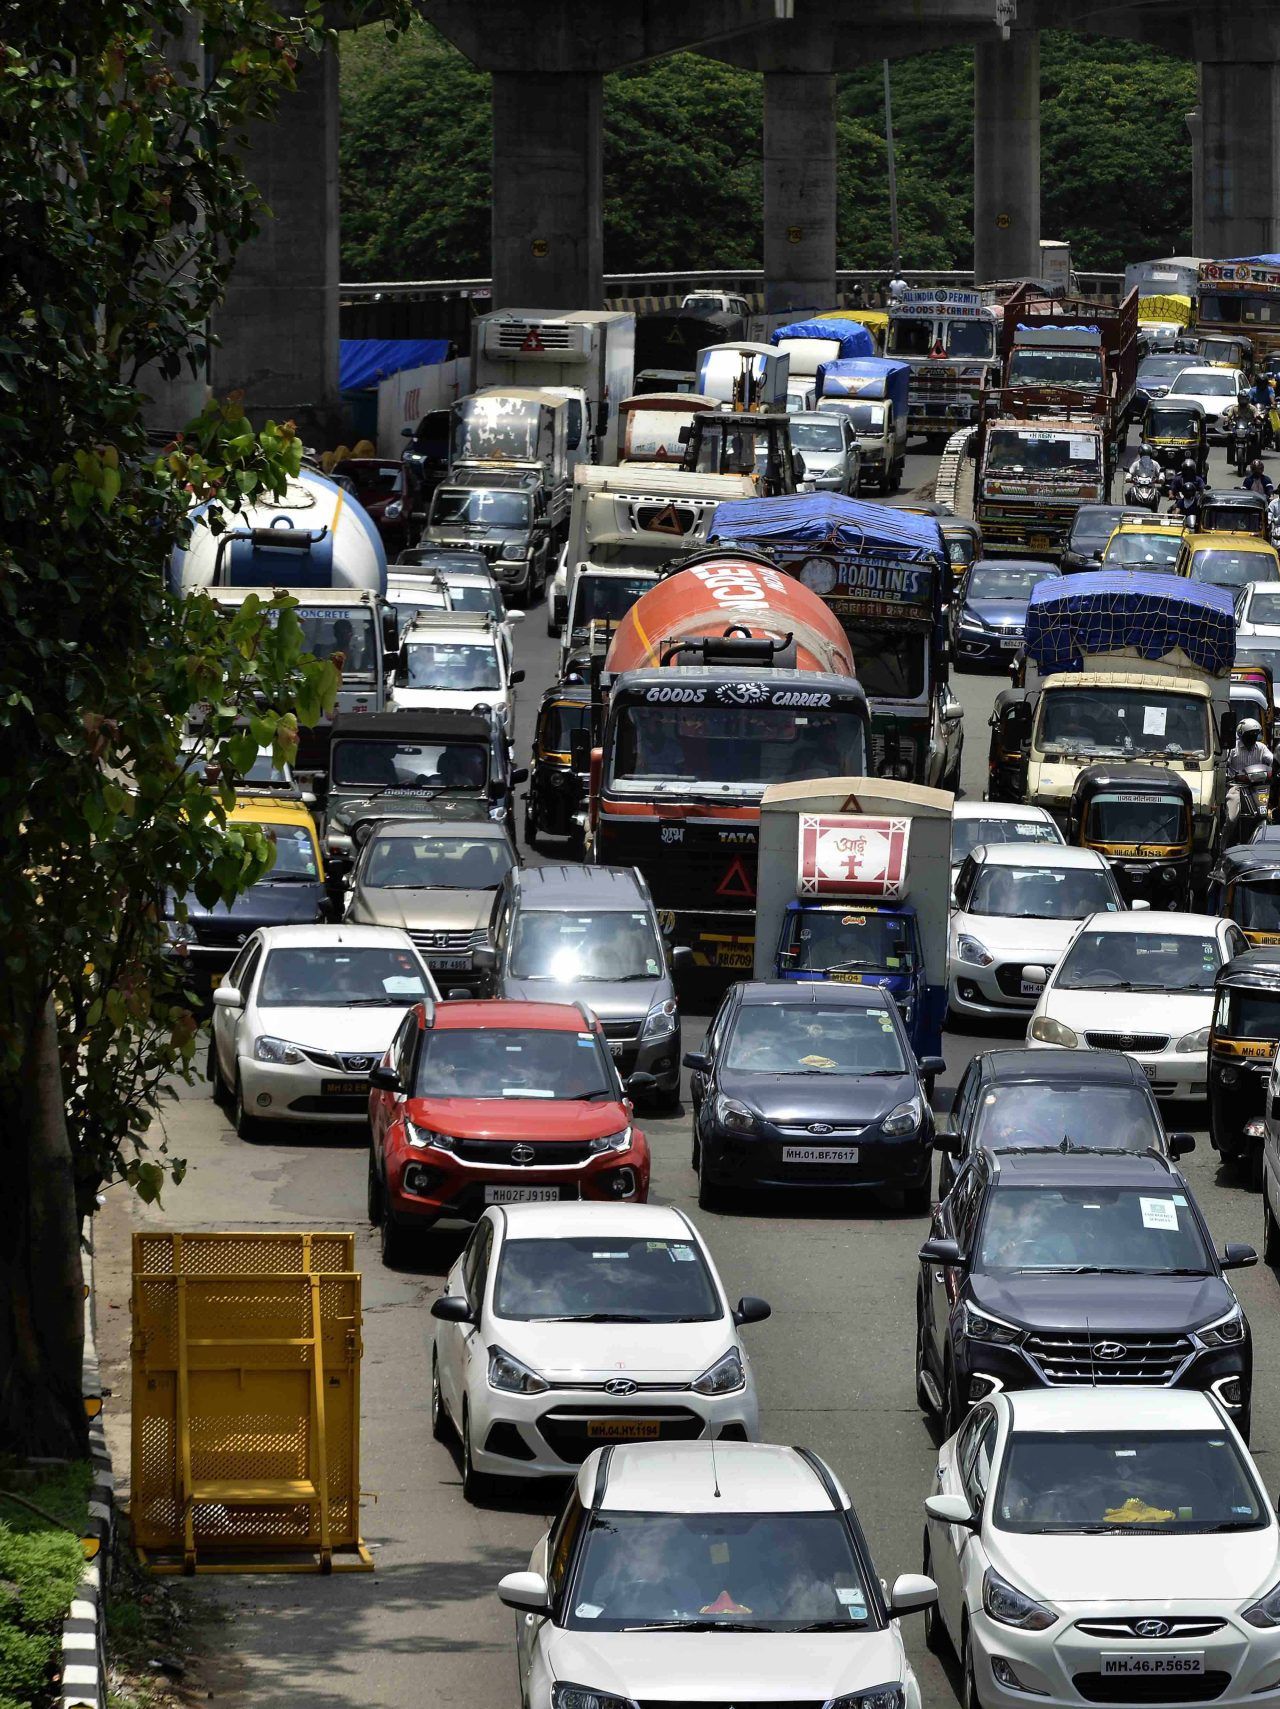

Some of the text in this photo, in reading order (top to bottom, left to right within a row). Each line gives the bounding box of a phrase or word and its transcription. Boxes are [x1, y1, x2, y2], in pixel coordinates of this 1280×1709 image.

[903, 290, 979, 304] ALL INDIA PERMIT
[902, 306, 981, 316] GOODS CARRIER
[849, 557, 890, 568] PERMIT
[838, 563, 919, 593] ROADLINES
[848, 587, 902, 601] CARRIER
[646, 688, 831, 708] GOODS CARRIER
[719, 831, 756, 844] TATA
[1242, 1047, 1254, 1056] MH
[786, 1150, 855, 1160] MH.01.BF.7617
[493, 1190, 558, 1201] MH02FJ9199
[1105, 1659, 1201, 1673] MH.46.P.5652
